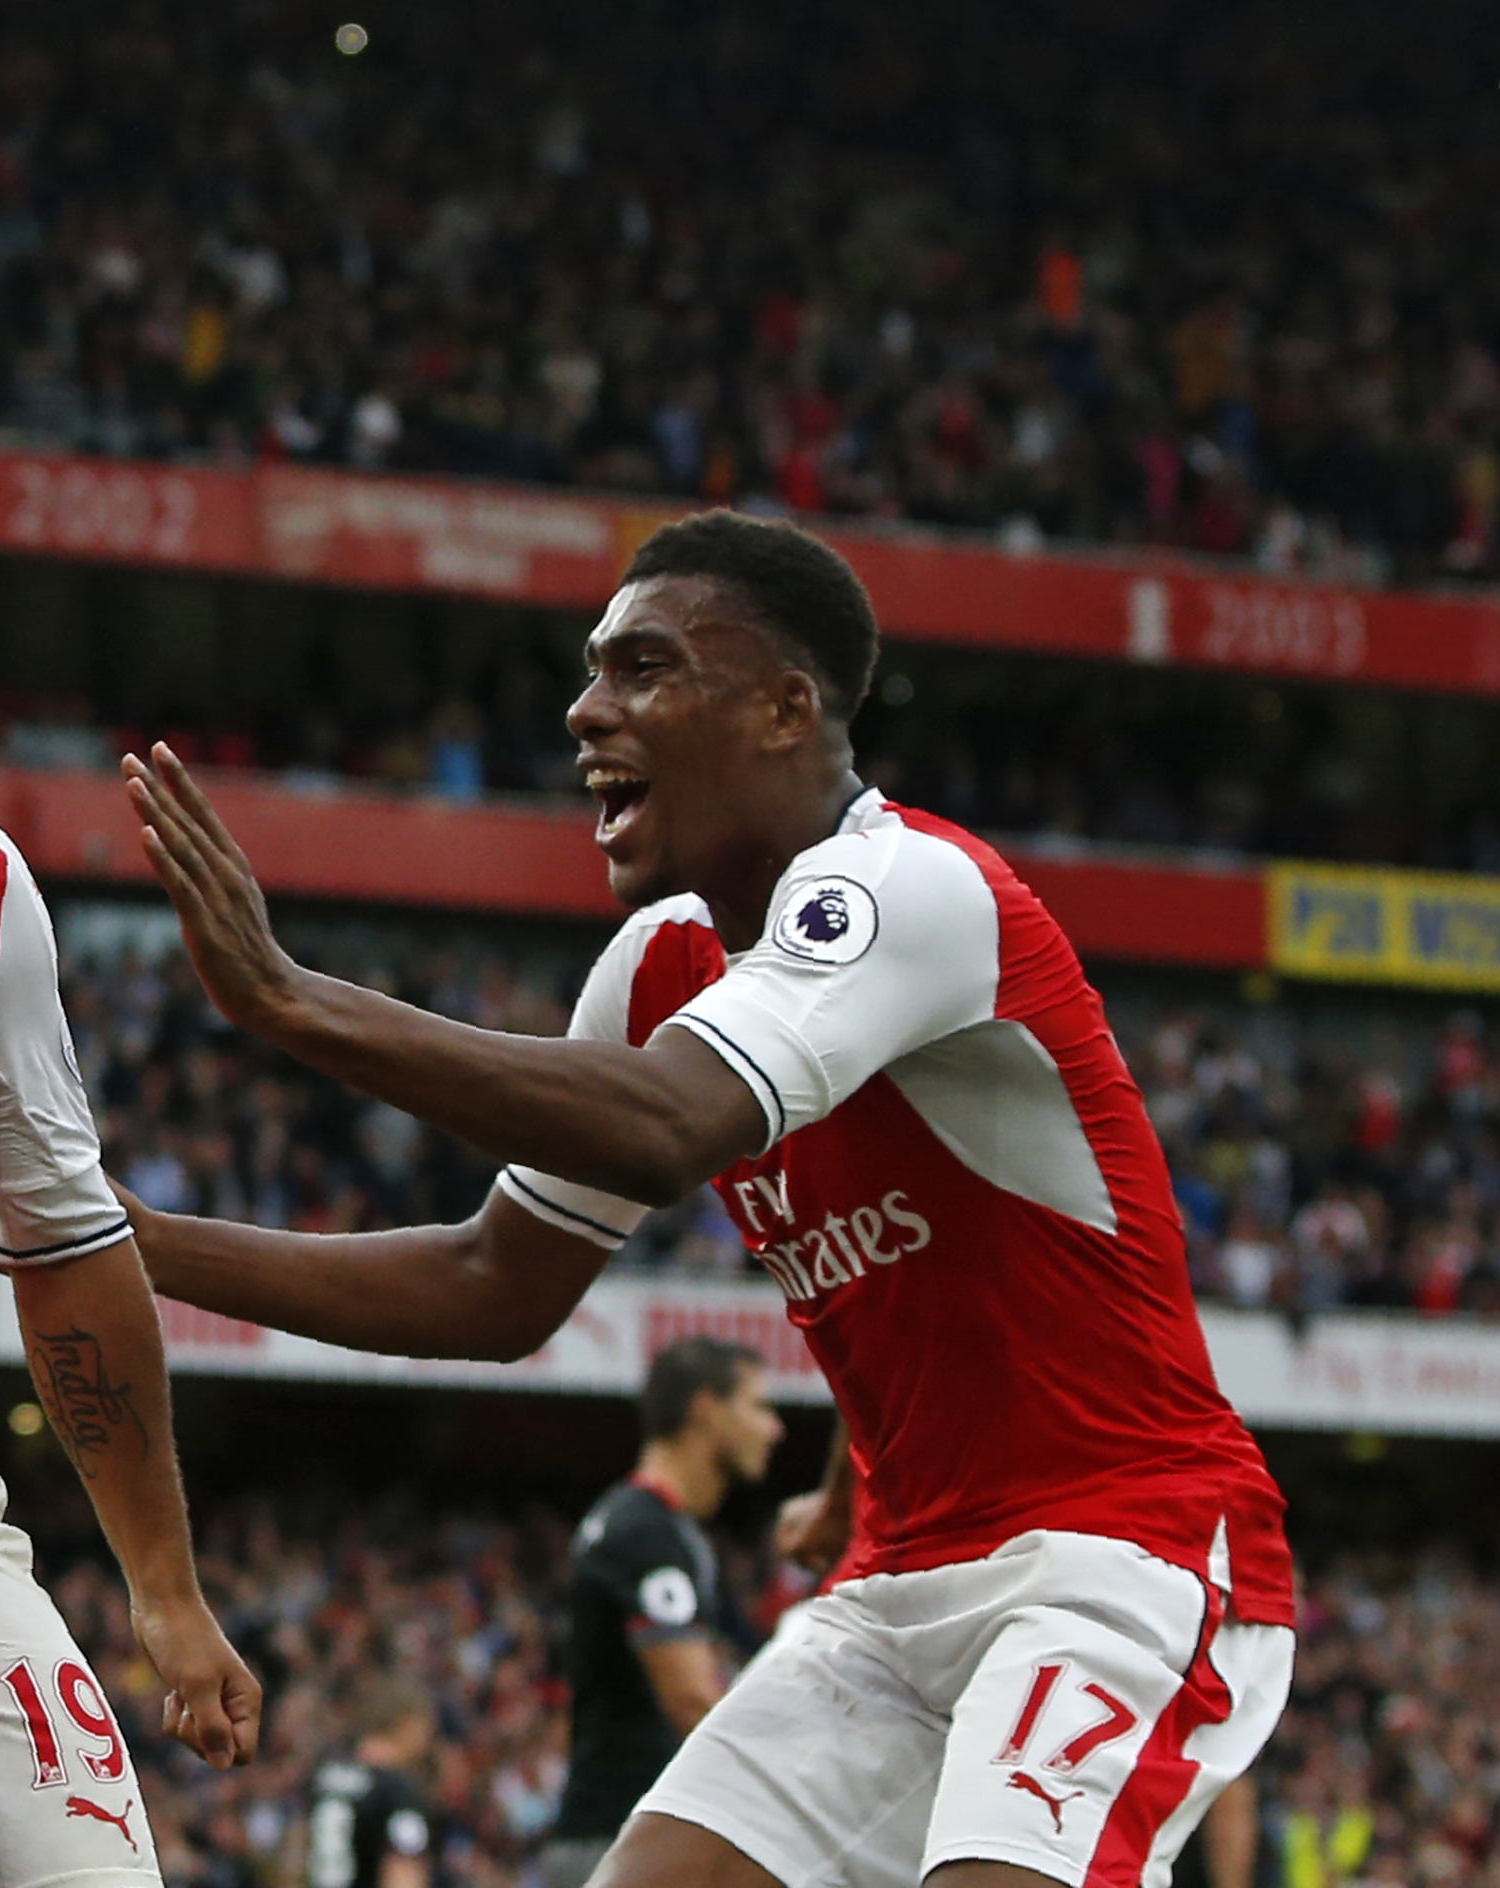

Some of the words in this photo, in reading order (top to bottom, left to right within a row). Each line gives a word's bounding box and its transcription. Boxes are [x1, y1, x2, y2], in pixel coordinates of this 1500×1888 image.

[8, 462, 198, 557] 2002
[0, 1656, 128, 1791] 19
[990, 1658, 1144, 1778] 17
